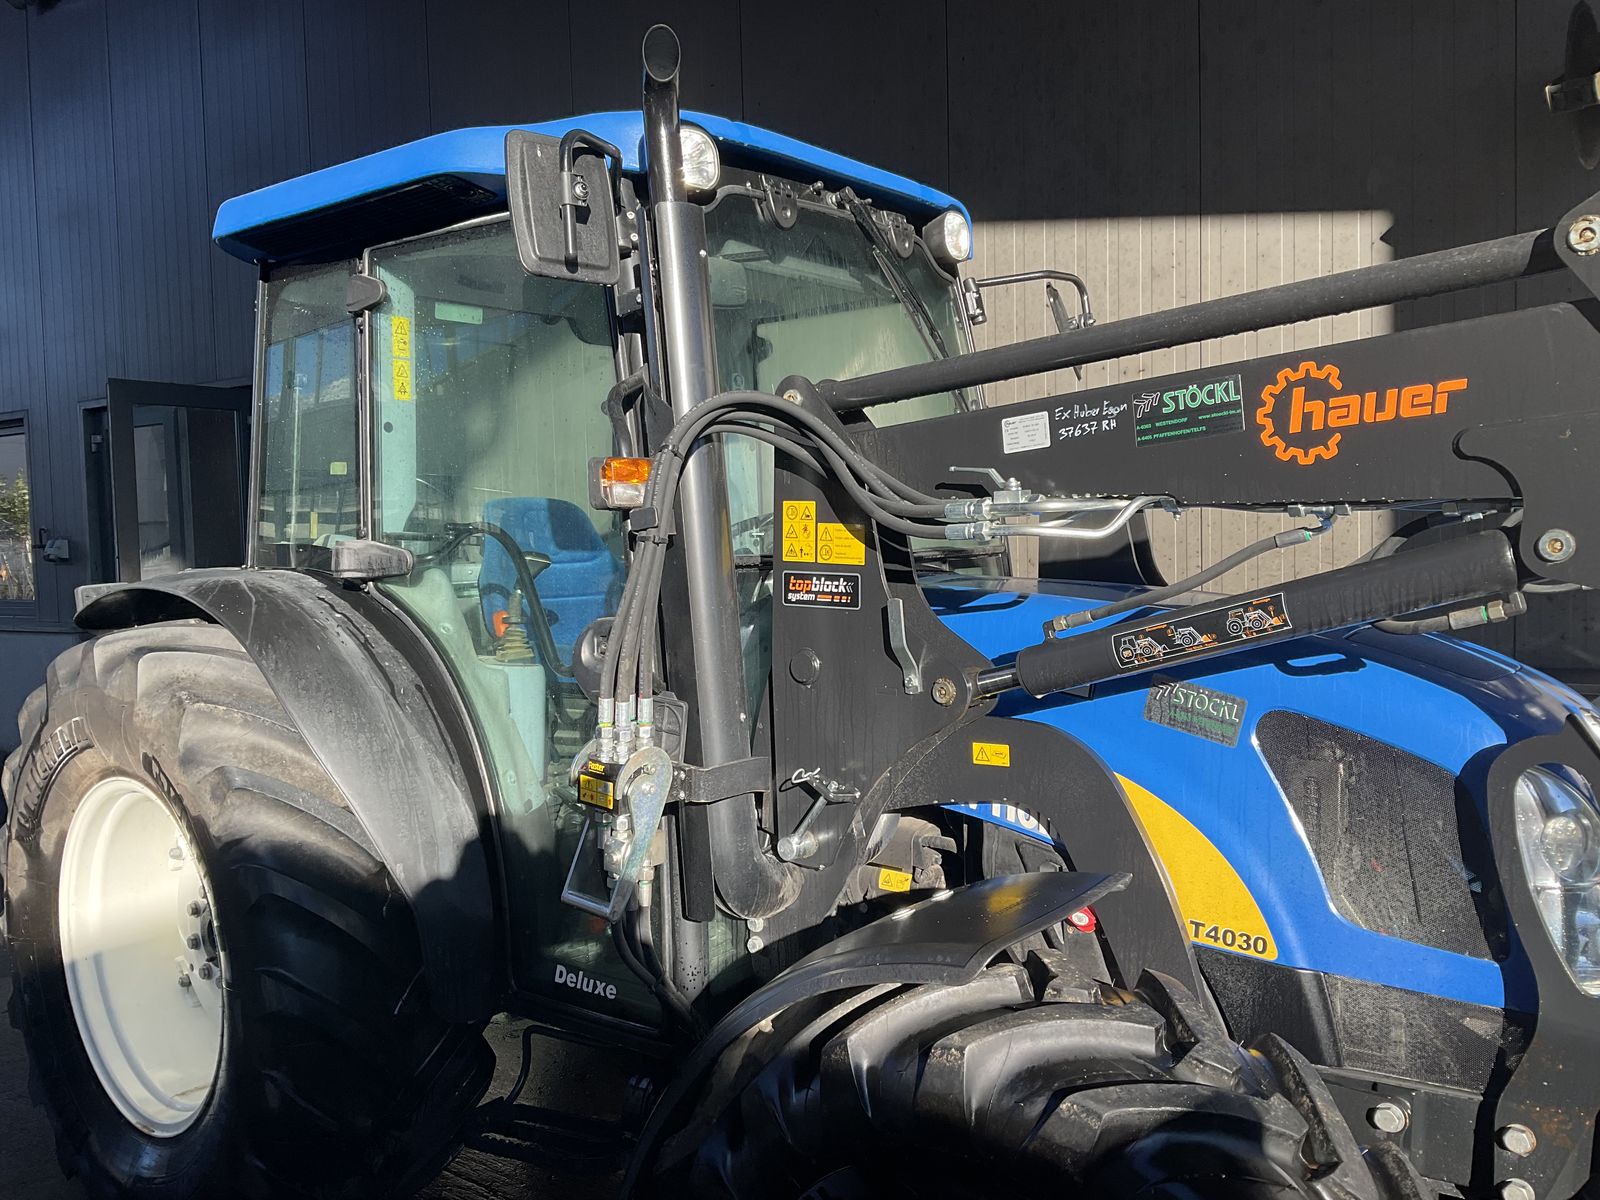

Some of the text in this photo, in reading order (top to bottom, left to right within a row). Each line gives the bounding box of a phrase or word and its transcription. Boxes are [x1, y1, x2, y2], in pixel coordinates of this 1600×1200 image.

[1162, 380, 1241, 414] STÖCKL
[1289, 378, 1468, 434] hauer
[1054, 407, 1072, 421] Ex
[1073, 403, 1100, 419] Huber
[1058, 419, 1117, 440] 37637 RH
[787, 592, 816, 602] system
[789, 575, 847, 593] topblock
[1188, 919, 1268, 955] T4030
[554, 964, 617, 1000] Deluxe
